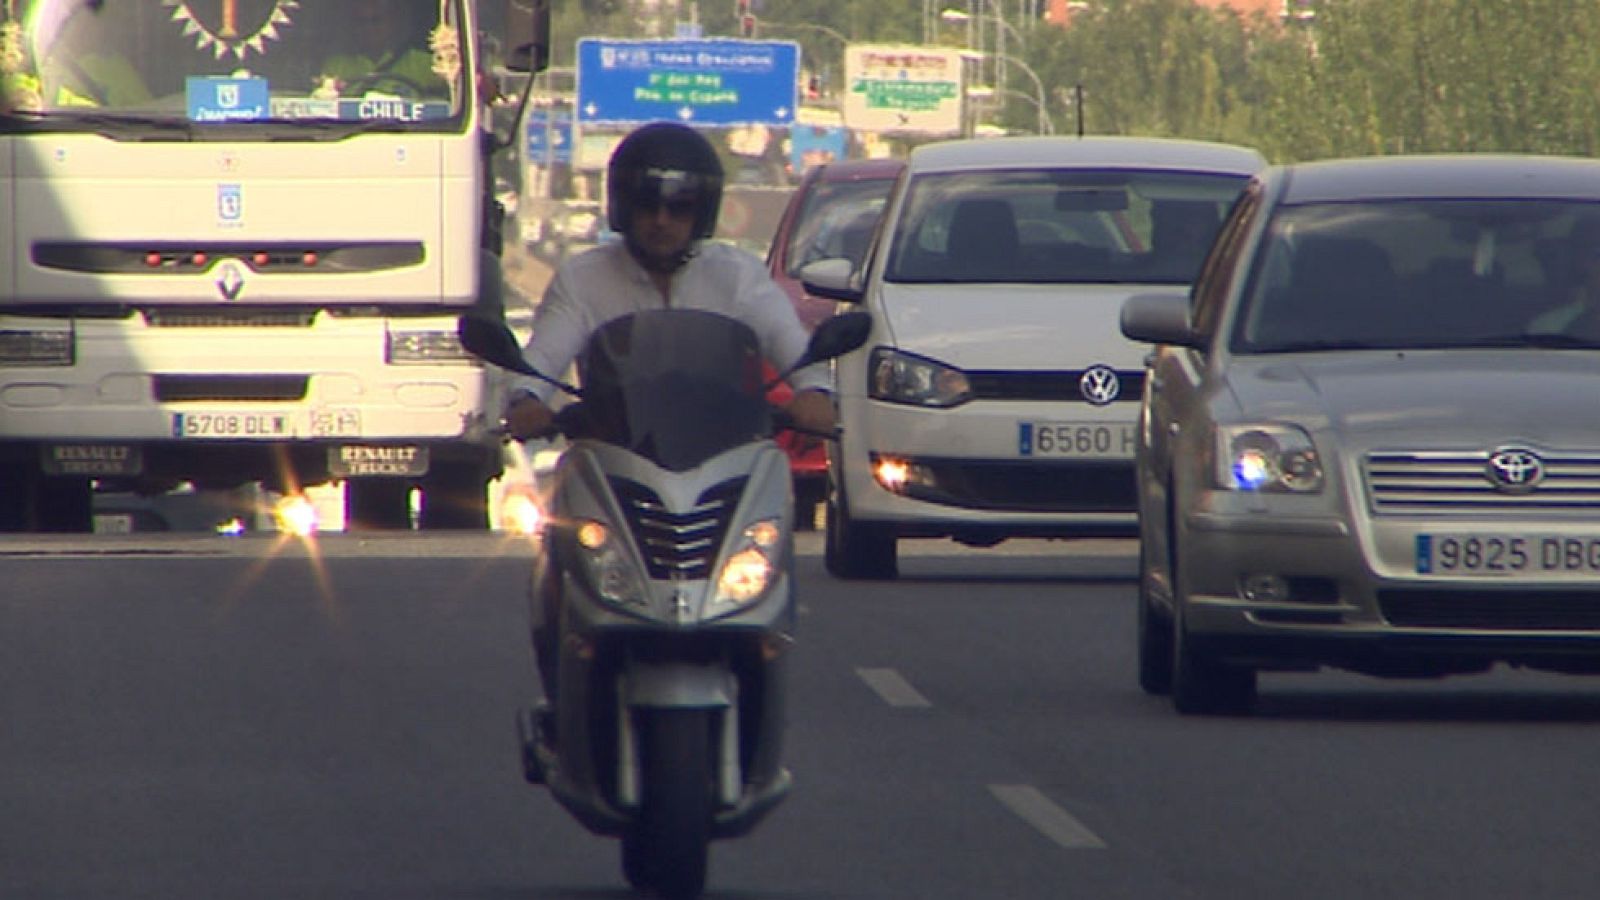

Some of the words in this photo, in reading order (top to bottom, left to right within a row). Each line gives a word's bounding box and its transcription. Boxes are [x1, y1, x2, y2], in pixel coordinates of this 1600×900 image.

[186, 415, 239, 434] 5708
[1037, 426, 1111, 453] 6560
[54, 445, 128, 460] RENAULT
[341, 445, 416, 460] RENAULT
[63, 462, 123, 473] TRUCKS
[348, 462, 409, 473] TRUCKS
[1440, 538, 1528, 570] 9825
